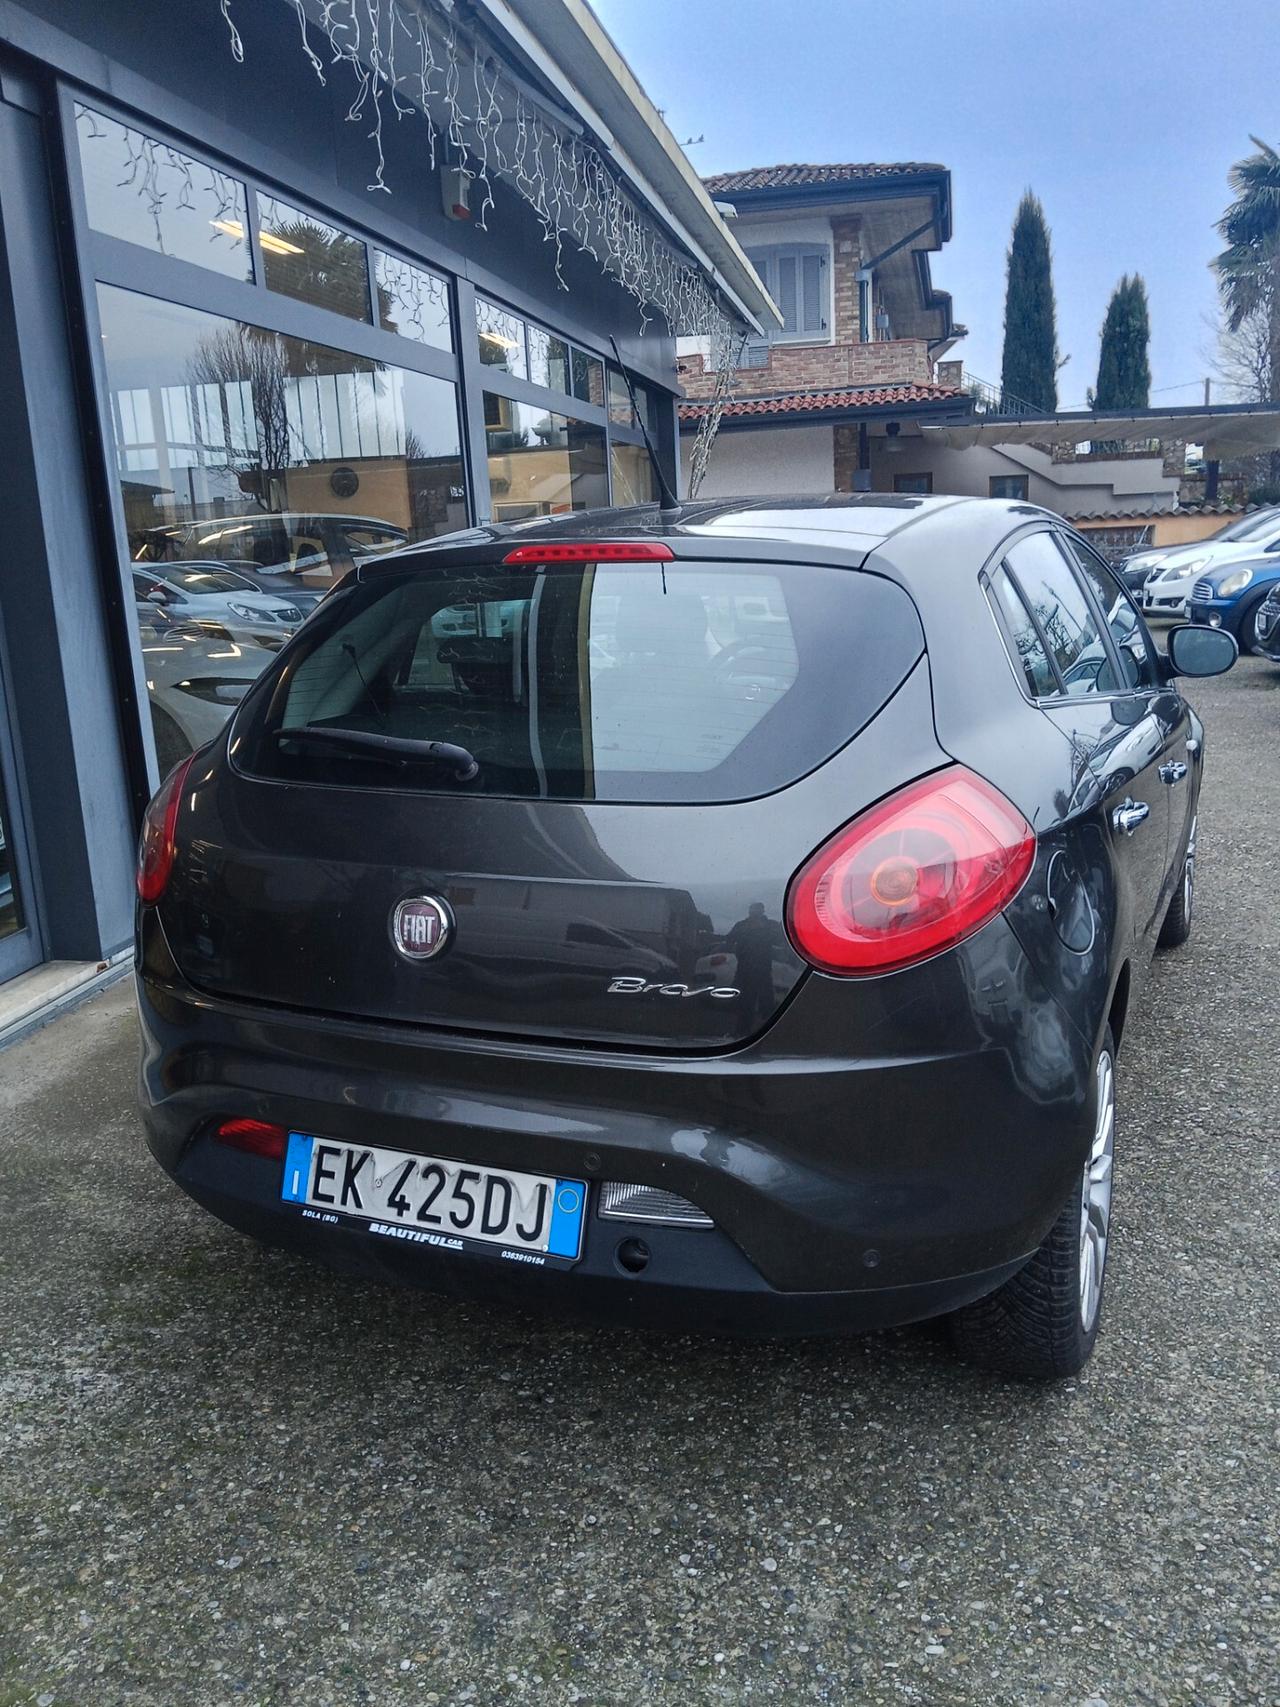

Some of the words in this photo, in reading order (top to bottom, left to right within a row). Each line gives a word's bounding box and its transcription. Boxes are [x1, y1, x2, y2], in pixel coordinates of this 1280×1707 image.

[403, 914, 436, 945] FIAT
[607, 976, 741, 998] Bravo
[312, 1145, 370, 1210] EK
[387, 1160, 548, 1242] 425DJ
[302, 1209, 321, 1220] SOLA
[368, 1222, 460, 1250] BEAUTIFUL
[447, 1238, 464, 1247] CAR
